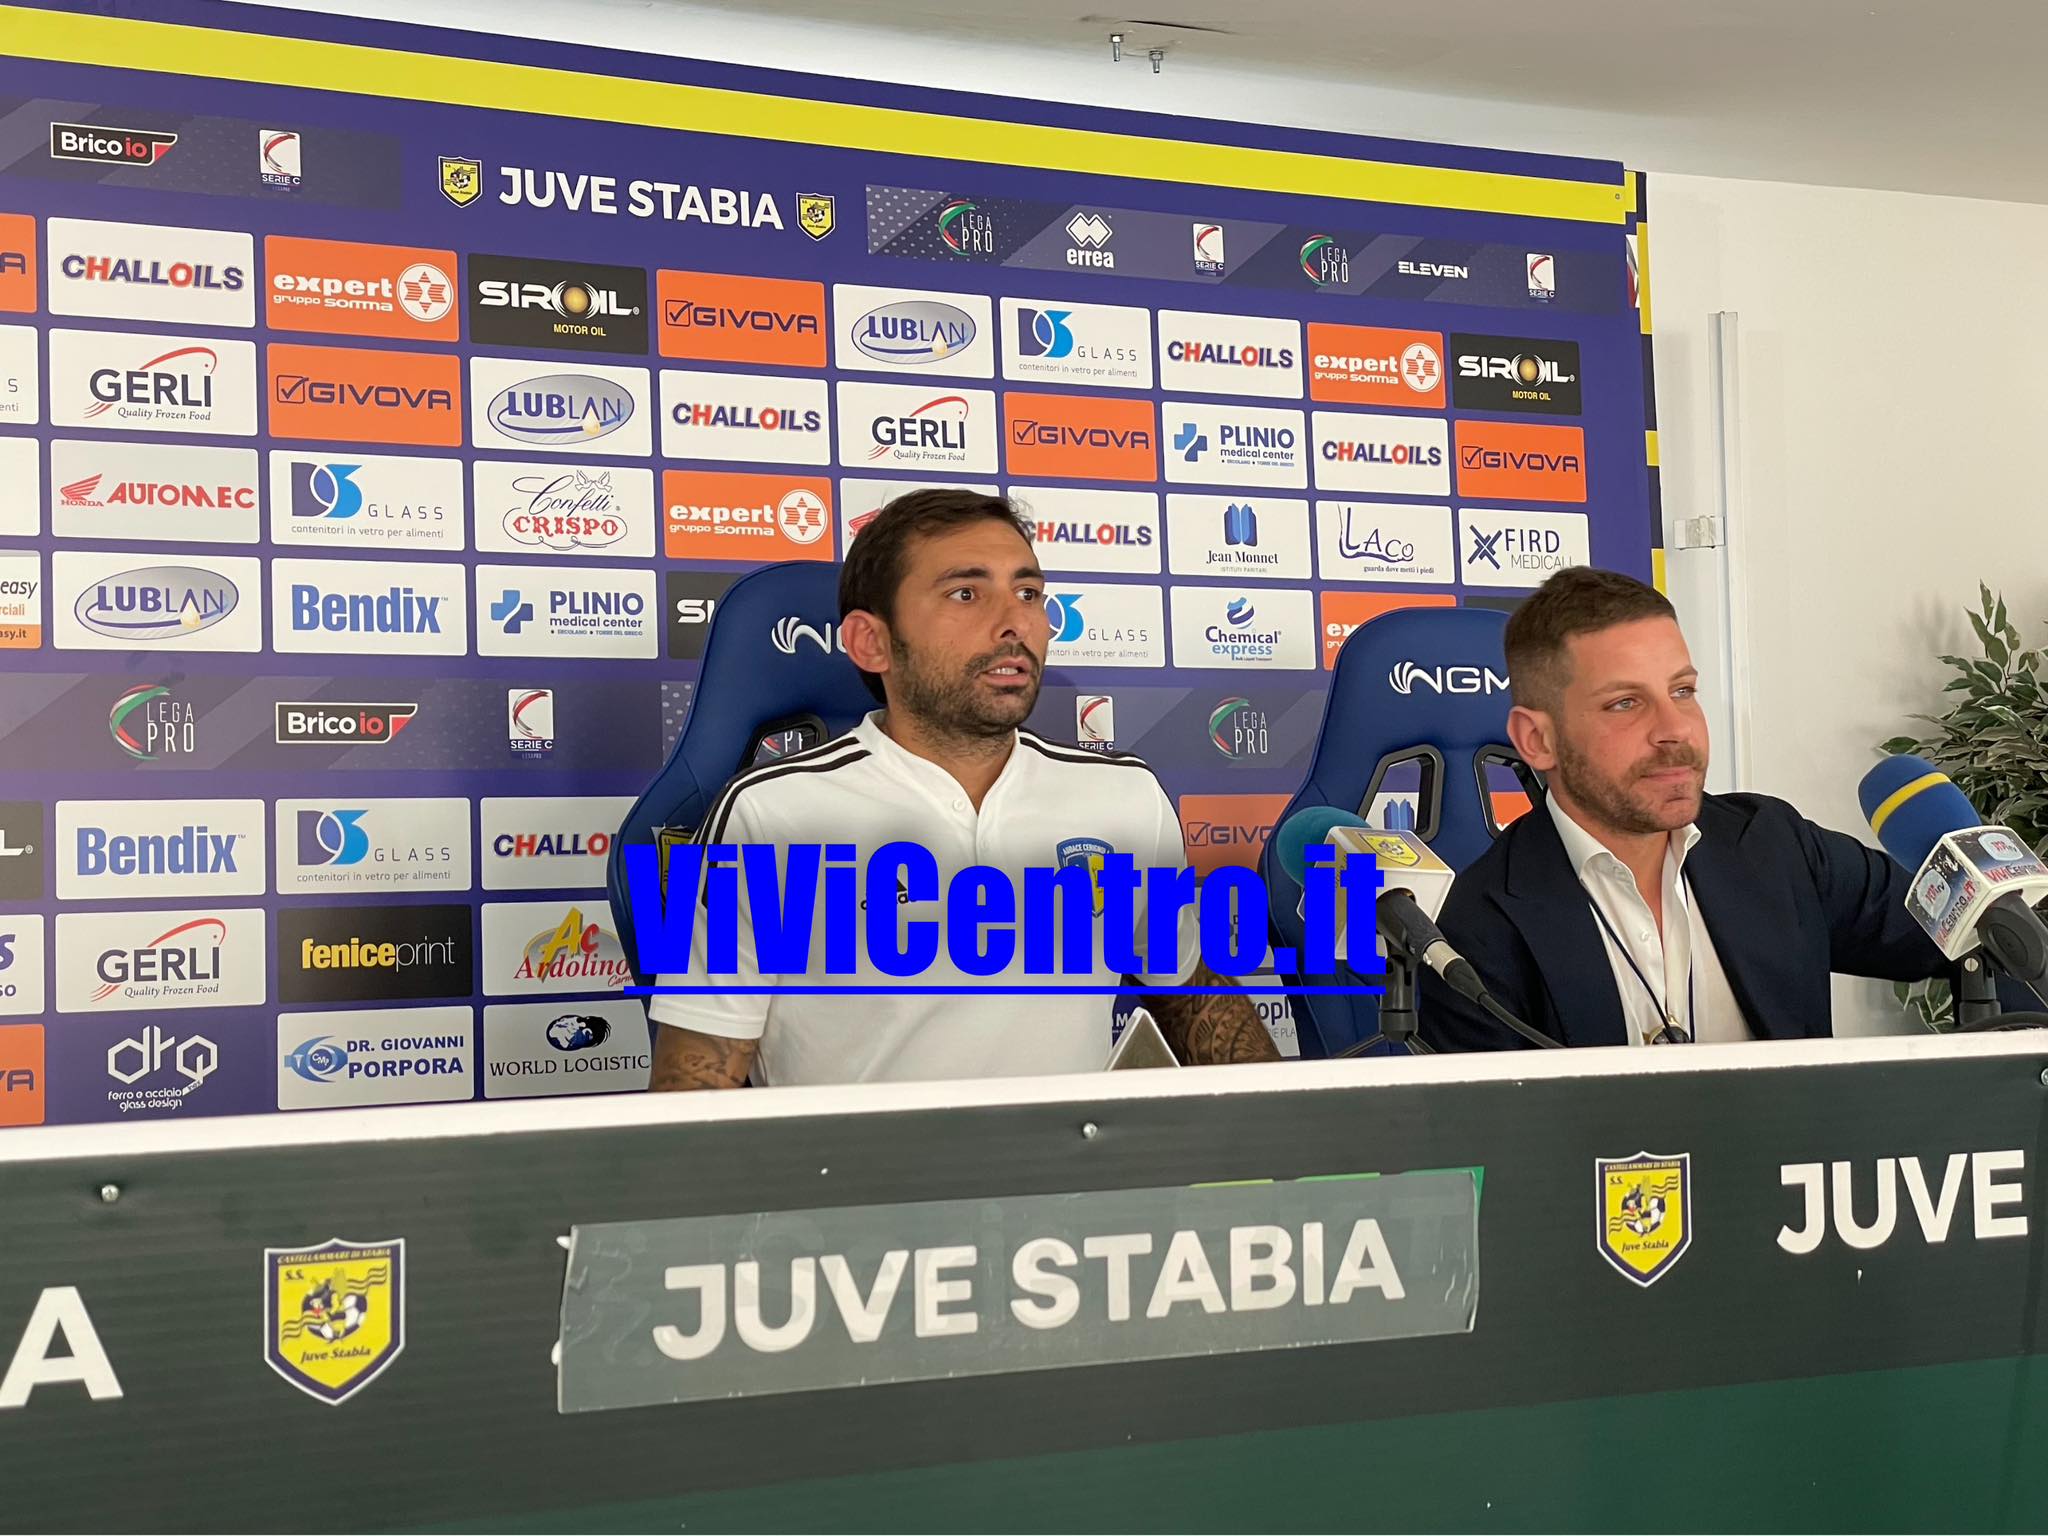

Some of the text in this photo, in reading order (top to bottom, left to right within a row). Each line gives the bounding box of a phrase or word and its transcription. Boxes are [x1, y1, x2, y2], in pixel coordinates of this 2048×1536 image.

[262, 174, 301, 185] SERIE C
[499, 166, 785, 231] JUVE STABIA
[960, 213, 992, 232] LEGA
[961, 229, 993, 253] PRO
[1066, 247, 1114, 269] errea
[1319, 246, 1348, 264] LEGA
[62, 254, 244, 291] CHALLOILS
[1195, 261, 1217, 270] SERIE
[1320, 261, 1350, 283] PRO
[1398, 260, 1469, 279] ELEVEN
[273, 272, 392, 299] expert
[273, 294, 393, 312] gruppo somma
[553, 323, 606, 337] MOTOR OIL
[692, 306, 818, 335] GIVOVA
[869, 315, 966, 344] LUBLAN
[1077, 346, 1138, 362] GLASS
[1167, 341, 1293, 369] CHALLOILS
[1018, 362, 1138, 378] contenitori in vetro per alimenti
[1314, 354, 1398, 374] expert
[1314, 371, 1398, 385] gruppo somma
[89, 368, 211, 408] GERLI
[308, 382, 451, 411] GIVOVA
[1512, 390, 1551, 401] MOTOR OIL
[118, 407, 211, 422] Quality Frozen Food
[507, 391, 622, 422] LUBLAN
[672, 403, 821, 432] CHALLOILS
[871, 414, 966, 449] GERLI
[1037, 425, 1150, 450] GIVOVA
[1220, 425, 1295, 449] PLINIO
[893, 449, 966, 462] Quality Frozen Food
[1220, 448, 1294, 460] medical center
[1322, 440, 1441, 467] CHALLOILS
[1482, 451, 1579, 473] GIVOVA
[60, 499, 104, 507] HONDA
[107, 483, 255, 509] AUTOMEC
[512, 477, 614, 515] Confetti
[368, 504, 443, 521] GLASS
[670, 503, 774, 524] expert
[291, 523, 444, 540] contenitori in vetro per alimenti
[512, 514, 618, 538] CRISPO
[670, 523, 774, 537] gruppo somma
[1505, 528, 1560, 553] FIRD
[1206, 550, 1279, 564] Jean Monnet
[1364, 565, 1384, 573] guarda
[97, 585, 224, 614] LUBLAN
[291, 584, 441, 633] Bendix
[550, 591, 644, 615] PLINIO
[550, 616, 643, 627] medical center
[1088, 628, 1147, 642] GLASS
[1205, 626, 1278, 644] Chemical
[1104, 650, 1116, 660] per
[1119, 649, 1149, 658] alimenti
[1212, 644, 1272, 661] express
[147, 702, 193, 722] LEGA
[1234, 711, 1267, 729] LEGA
[147, 722, 194, 752] PRO
[511, 740, 553, 749] SERIE C
[1078, 741, 1114, 751] SERIE C
[1235, 728, 1268, 754] PRO
[77, 825, 238, 876] Bendix
[374, 847, 450, 862] GLASS
[297, 869, 451, 884] contenitori in vetro per alimenti
[96, 946, 220, 984] GERLI
[513, 953, 629, 979] Ardolino
[124, 983, 219, 998] Quality Frozen Food
[346, 1035, 465, 1053] DR. GIOVANNI
[349, 1057, 464, 1079] PORPORA
[490, 1060, 557, 1077] WORLD
[108, 1087, 182, 1101] ferro e acciaio
[119, 1098, 182, 1113] glass design
[1776, 1149, 2029, 1254] JUVE
[1622, 1240, 1669, 1254] Juve Stabia
[651, 1217, 1407, 1361] JUVE STABIA
[0, 1286, 124, 1408] A
[301, 1345, 371, 1364] Juve Stabia
